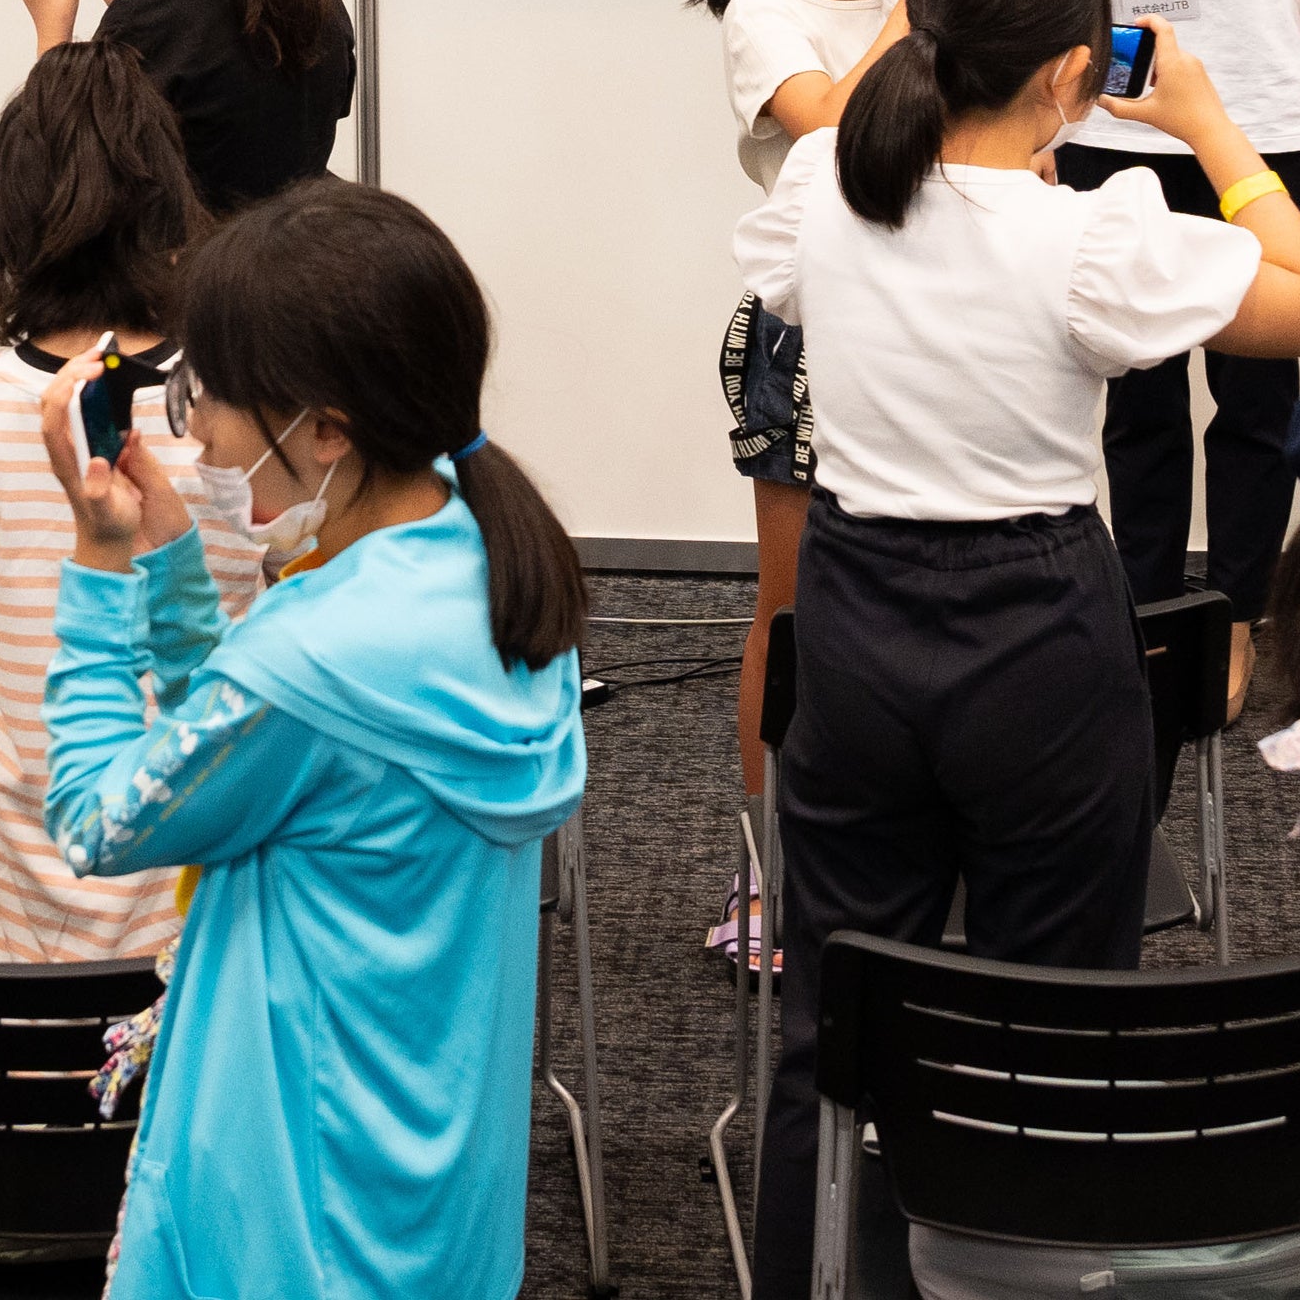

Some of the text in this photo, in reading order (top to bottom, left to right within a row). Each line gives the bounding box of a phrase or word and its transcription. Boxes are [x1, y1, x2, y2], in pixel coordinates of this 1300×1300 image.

[739, 290, 756, 310] YO
[726, 311, 751, 349] WITH
[724, 350, 745, 367] BE
[724, 374, 742, 404] YOU
[795, 443, 811, 465] BE
